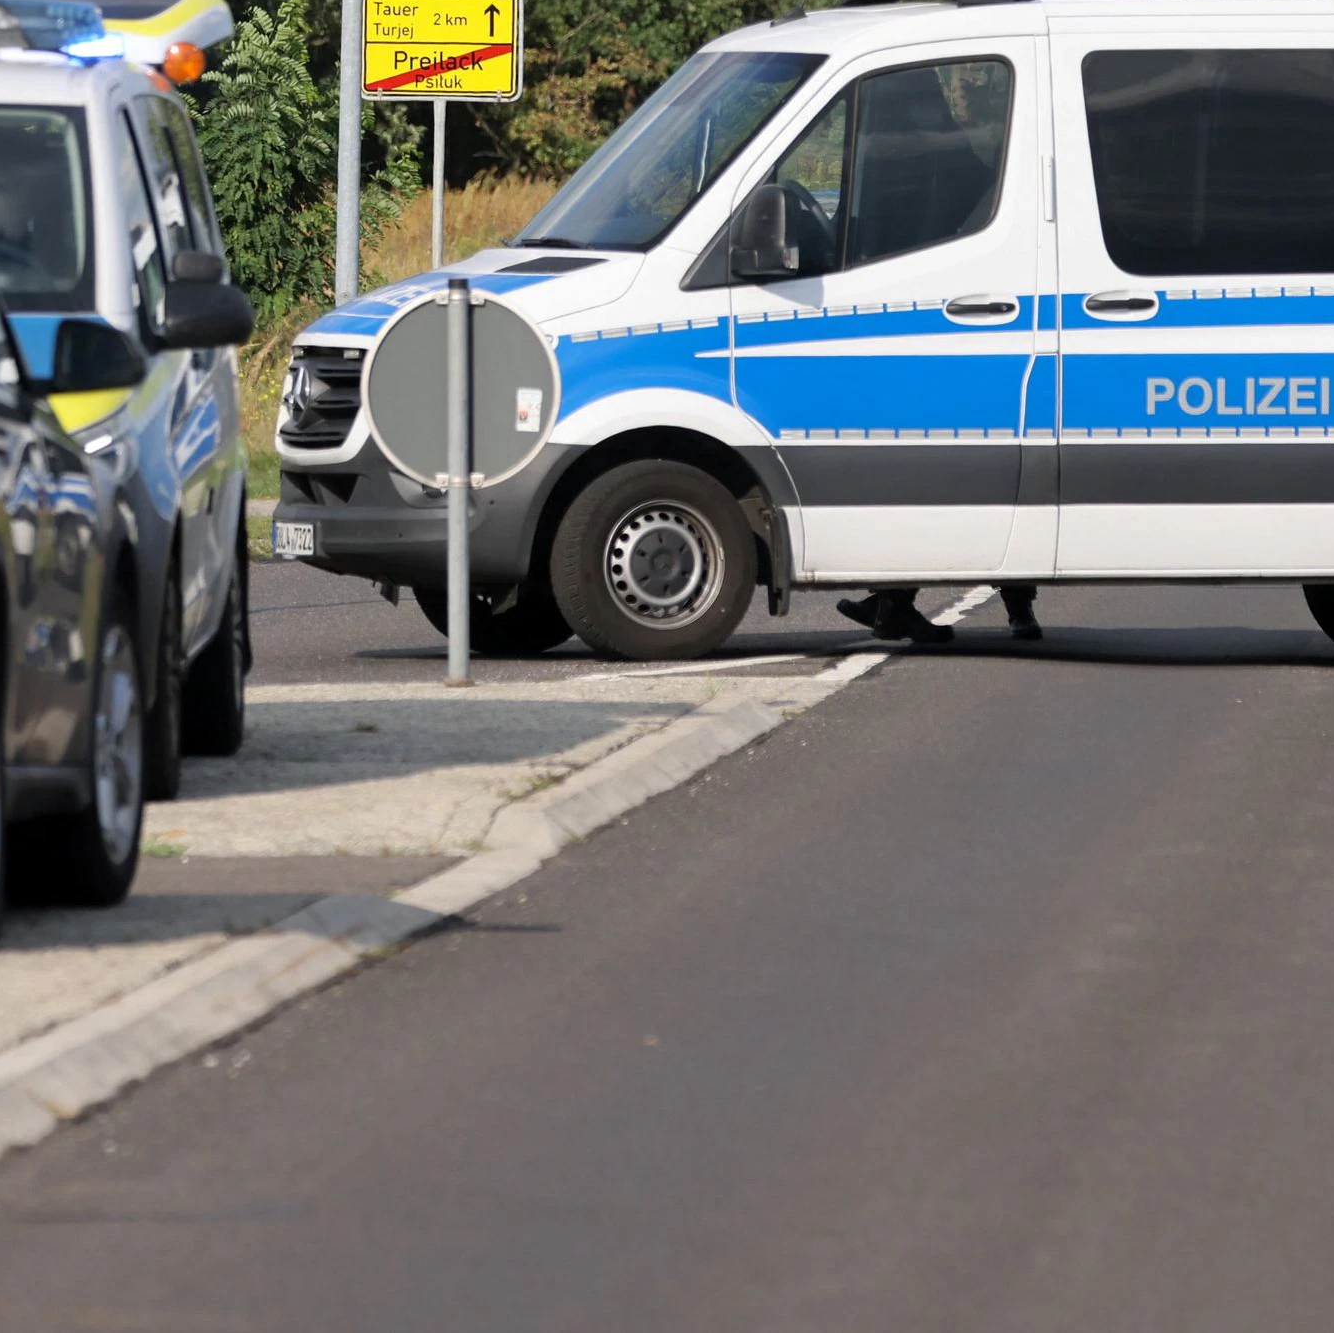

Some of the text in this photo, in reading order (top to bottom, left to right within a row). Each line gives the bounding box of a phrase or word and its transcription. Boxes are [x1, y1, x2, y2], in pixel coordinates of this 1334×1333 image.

[373, 1, 419, 17] Tauer
[433, 13, 468, 26] 2 km
[373, 23, 414, 40] Turjej
[394, 50, 484, 71] Preilack
[1146, 377, 1330, 416] POLIZEI
